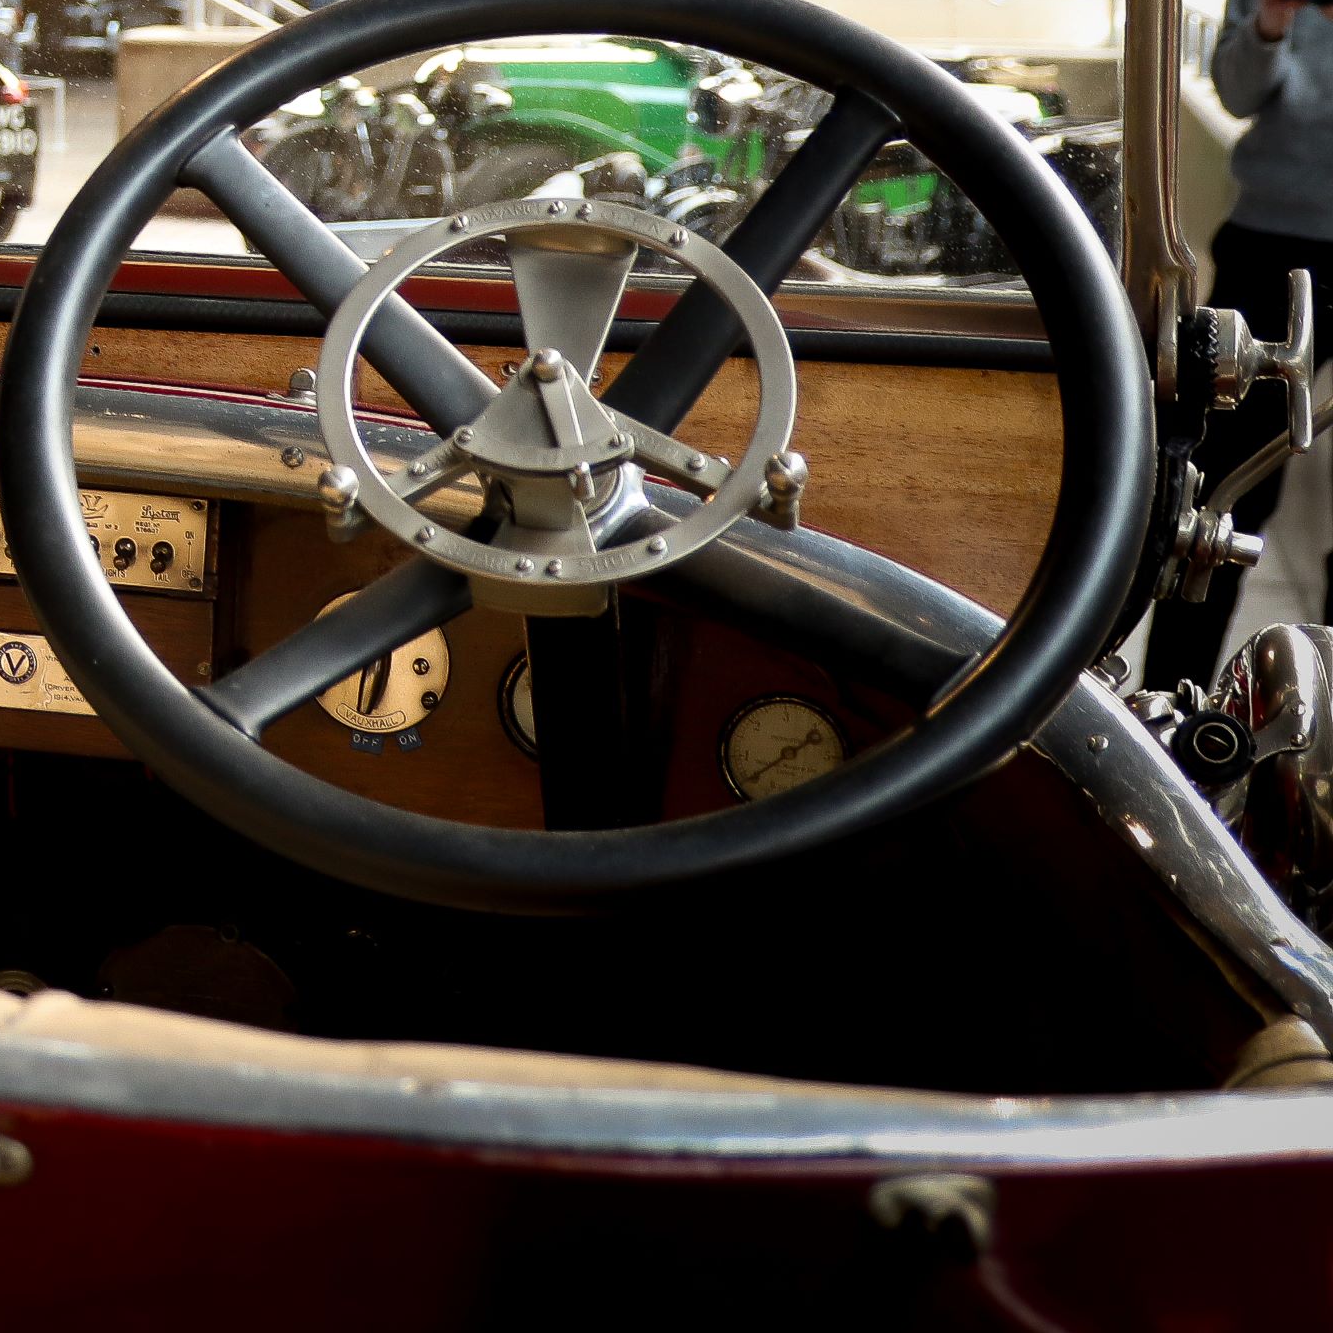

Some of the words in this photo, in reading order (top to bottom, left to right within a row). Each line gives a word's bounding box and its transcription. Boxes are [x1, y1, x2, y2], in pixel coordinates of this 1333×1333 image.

[185, 531, 194, 540] ON
[105, 569, 126, 578] IGHTS
[181, 570, 195, 578] OFF
[153, 574, 170, 583] TAIL
[345, 709, 399, 728] VAUXHALL
[353, 733, 380, 747] OFF
[399, 734, 417, 745] ON
